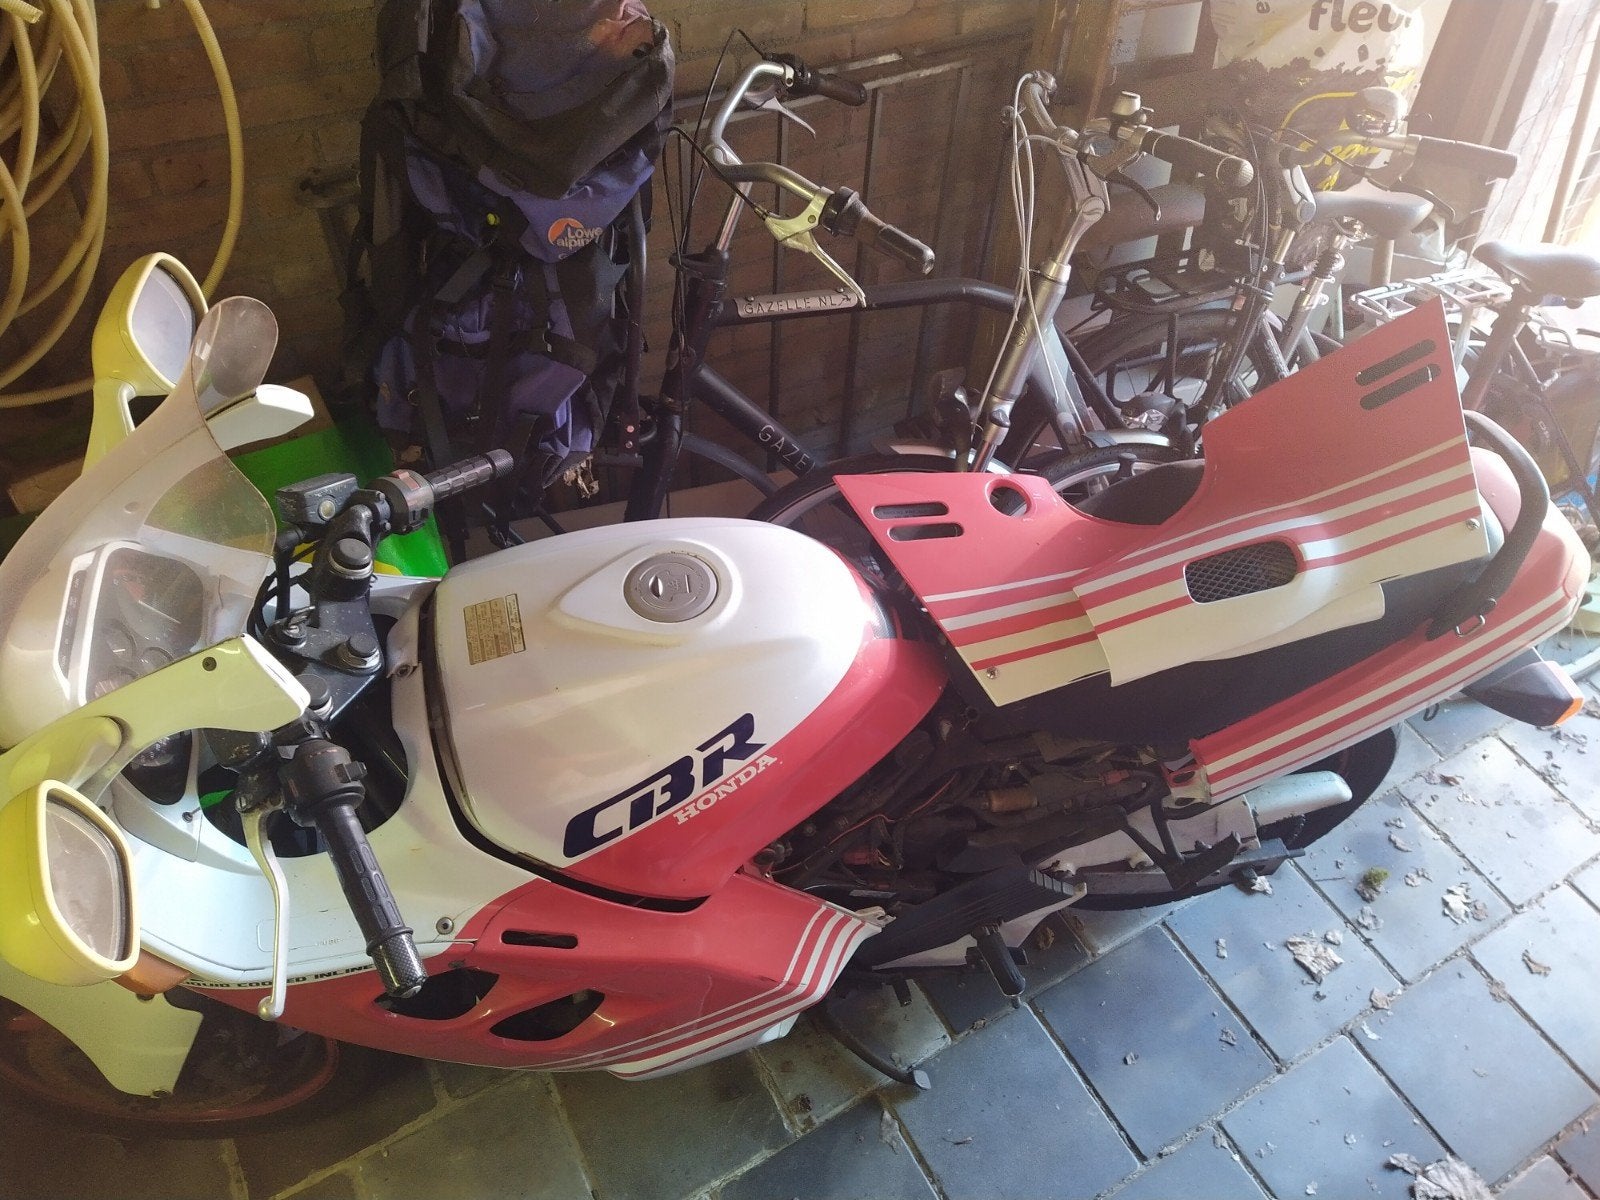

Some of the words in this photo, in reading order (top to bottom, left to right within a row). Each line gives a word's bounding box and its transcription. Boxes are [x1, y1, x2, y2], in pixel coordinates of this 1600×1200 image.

[744, 298, 811, 315] GAZELLE
[819, 295, 837, 307] NL
[562, 712, 768, 859] CBR
[672, 753, 778, 826] HONDA
